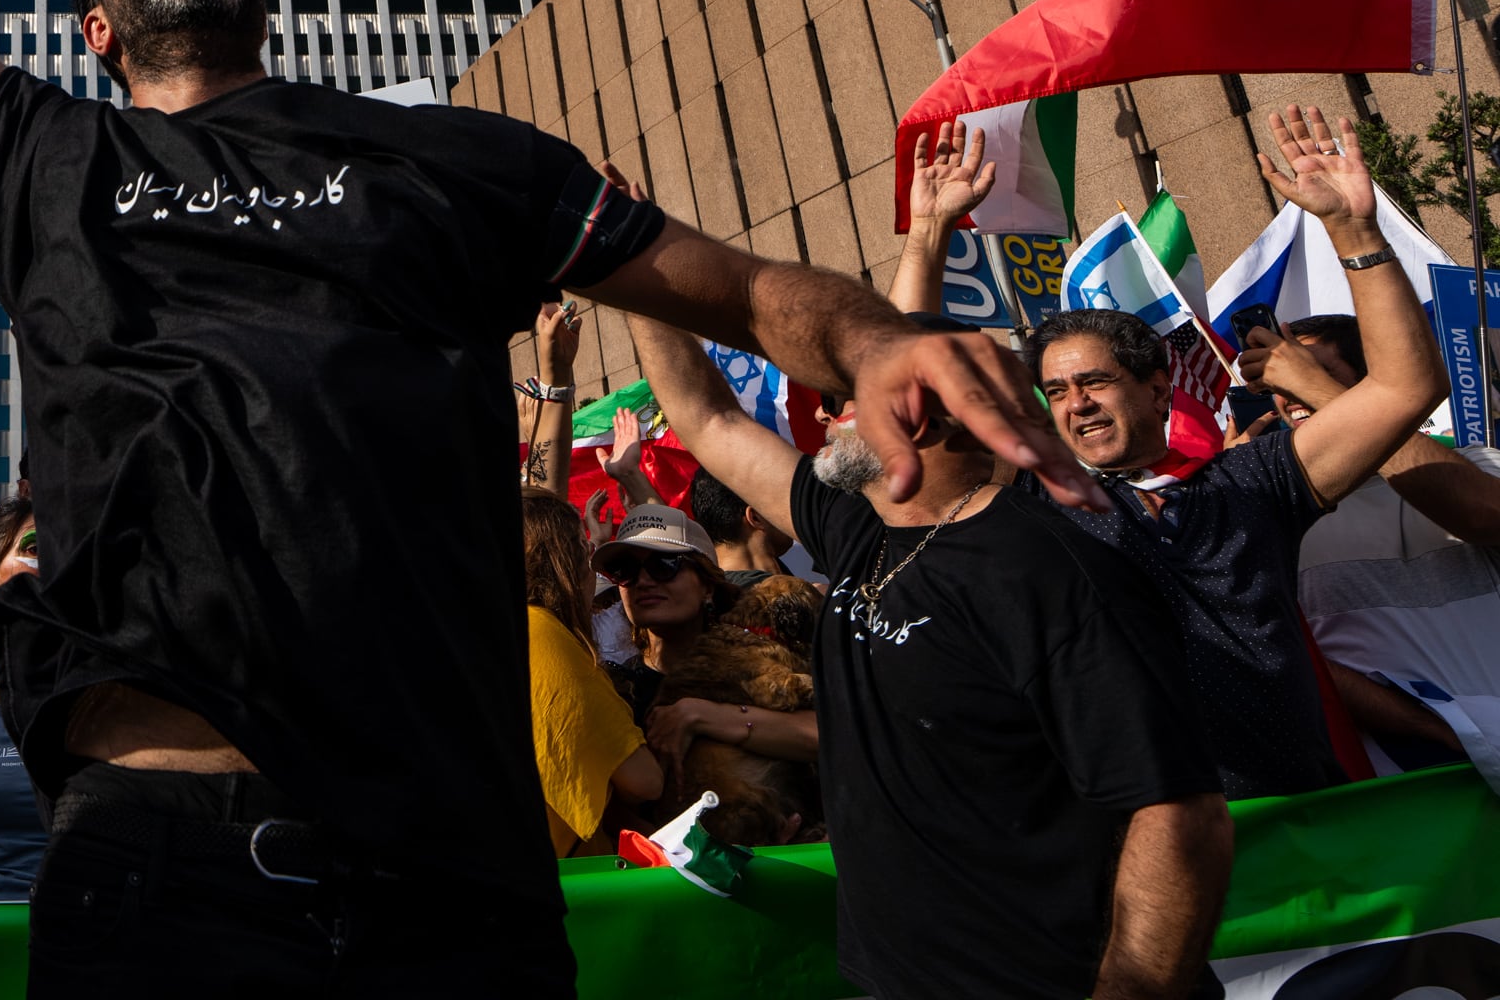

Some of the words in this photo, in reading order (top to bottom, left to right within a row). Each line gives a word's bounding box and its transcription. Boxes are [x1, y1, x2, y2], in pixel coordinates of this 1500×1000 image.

[115, 171, 184, 221] ایران
[1003, 234, 1043, 296] GO
[1451, 327, 1484, 447] PATRIOTISM
[636, 522, 667, 532] AGAIN
[638, 515, 664, 523] IRAN
